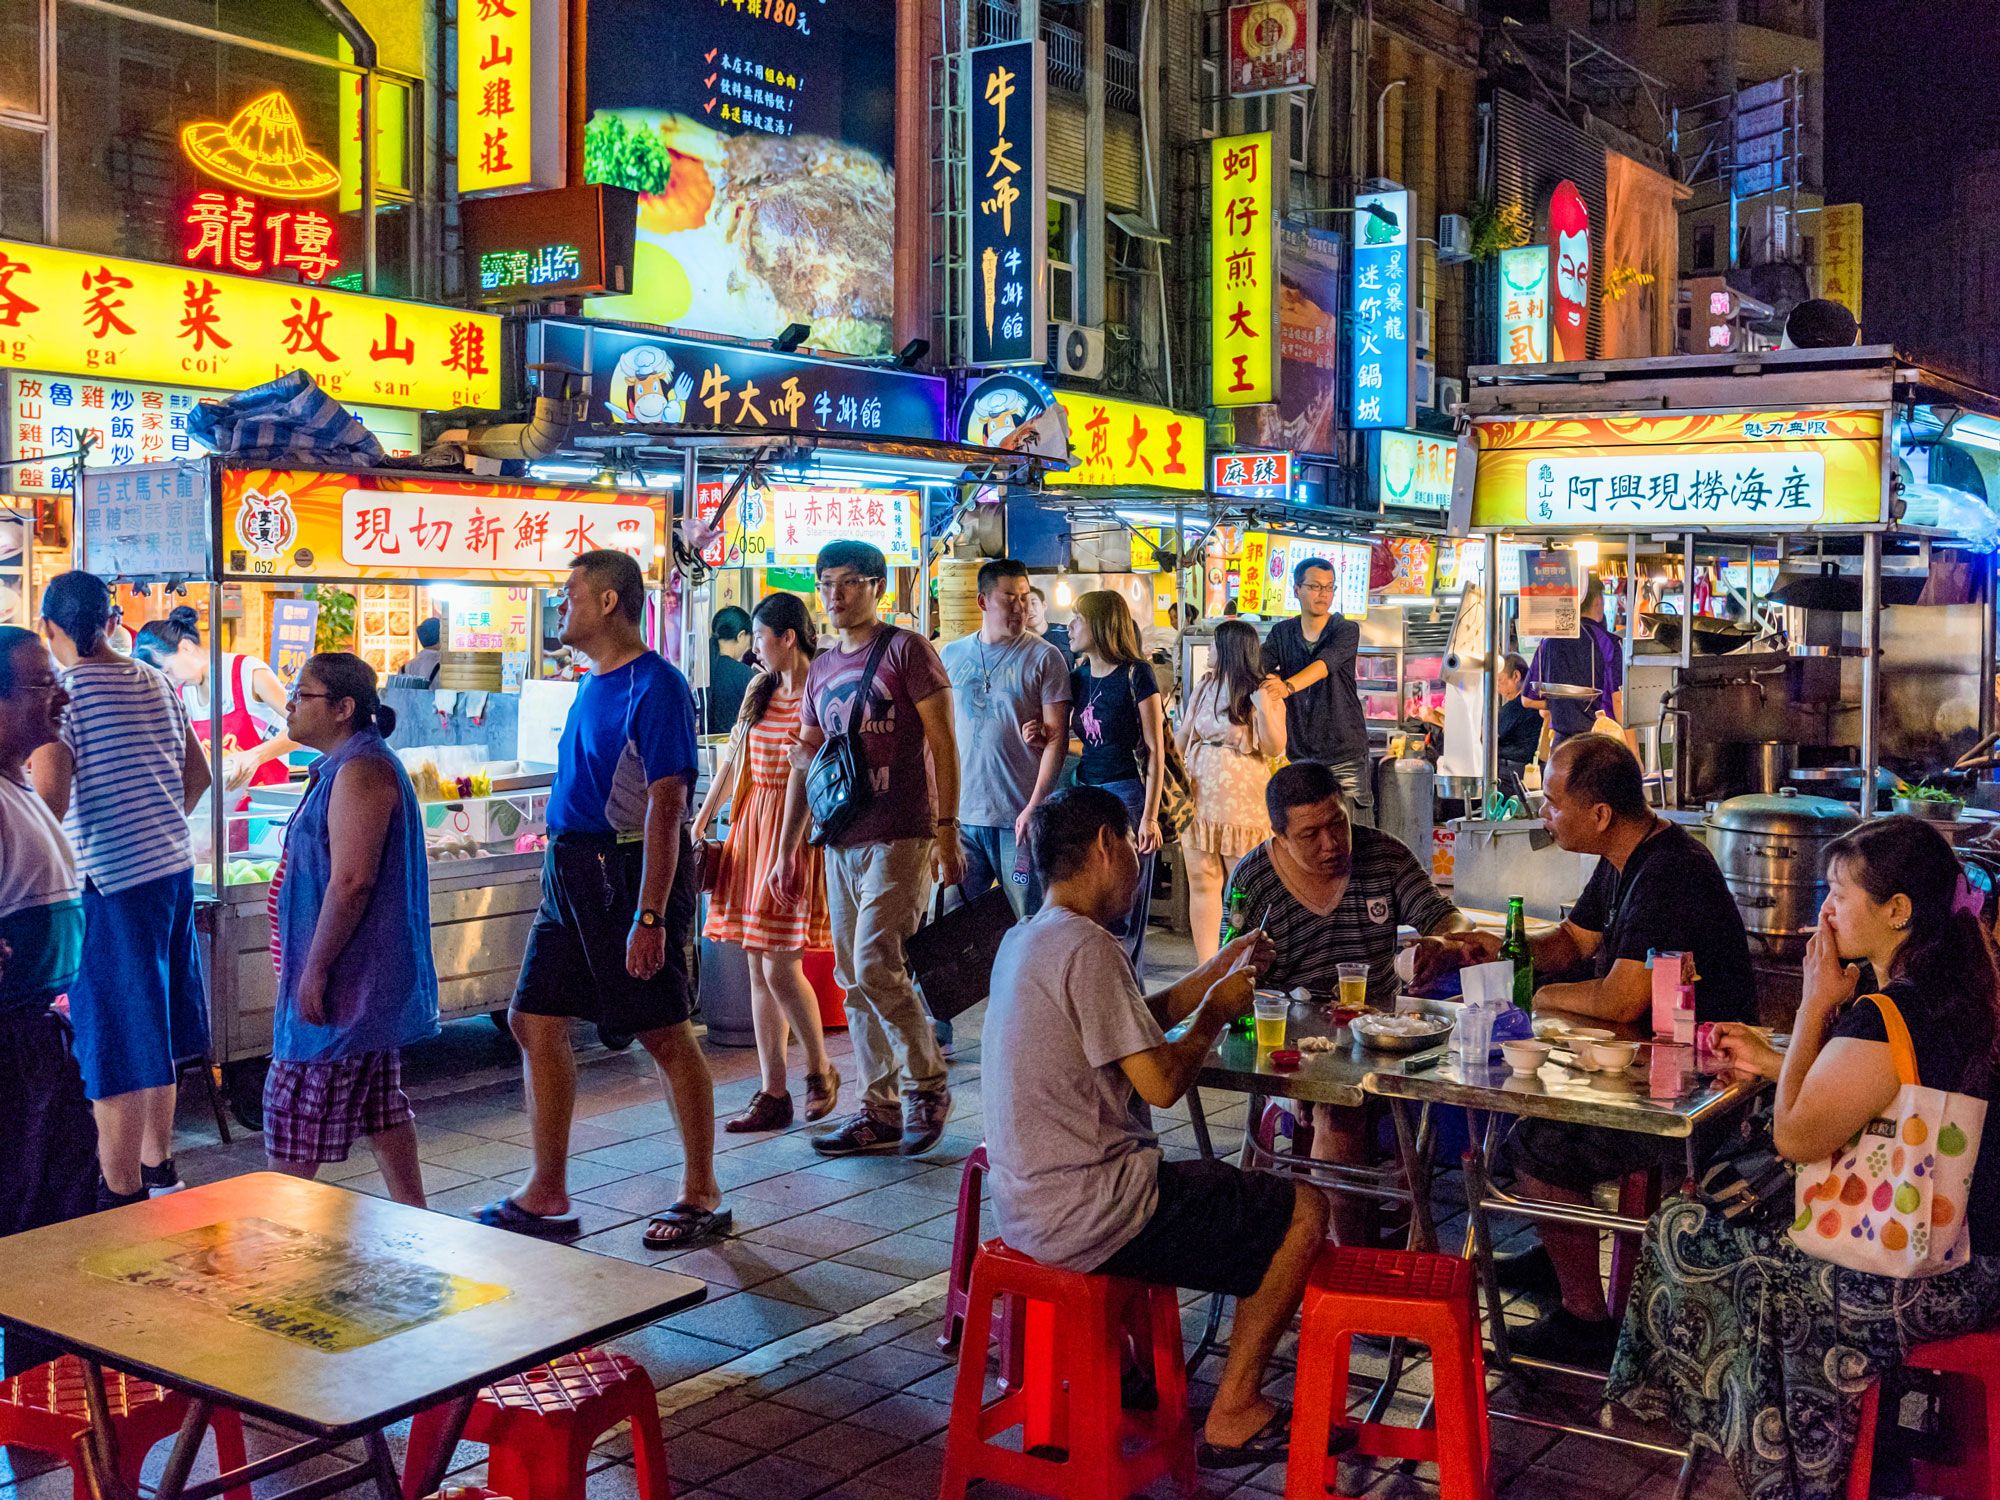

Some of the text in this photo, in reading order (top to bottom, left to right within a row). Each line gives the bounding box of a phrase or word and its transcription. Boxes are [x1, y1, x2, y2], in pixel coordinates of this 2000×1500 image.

[1000, 247, 1024, 339] 牛排館
[1223, 143, 1259, 393] 蚵仔煎大王
[0, 249, 489, 381] 客家菜放山雞
[1357, 266, 1383, 423] 迷你火鍋城
[699, 362, 882, 429] 牛大師 牛排館
[18, 379, 44, 488] 放山雞切盤
[49, 382, 74, 490] 魯肉飯
[1742, 420, 1829, 438] 魅力無限
[97, 474, 193, 504] 台式馬卡龍
[1223, 457, 1279, 483] 麻辣
[1538, 463, 1554, 520] 龜山島
[1567, 464, 1813, 513] 阿興現撈海產
[255, 509, 274, 544] 寧夏
[354, 505, 642, 562] 現切新鮮水果
[784, 502, 799, 546] 山東
[804, 495, 887, 527] 赤肉蒸餃
[254, 560, 273, 574] 052
[891, 541, 908, 552] 30元
